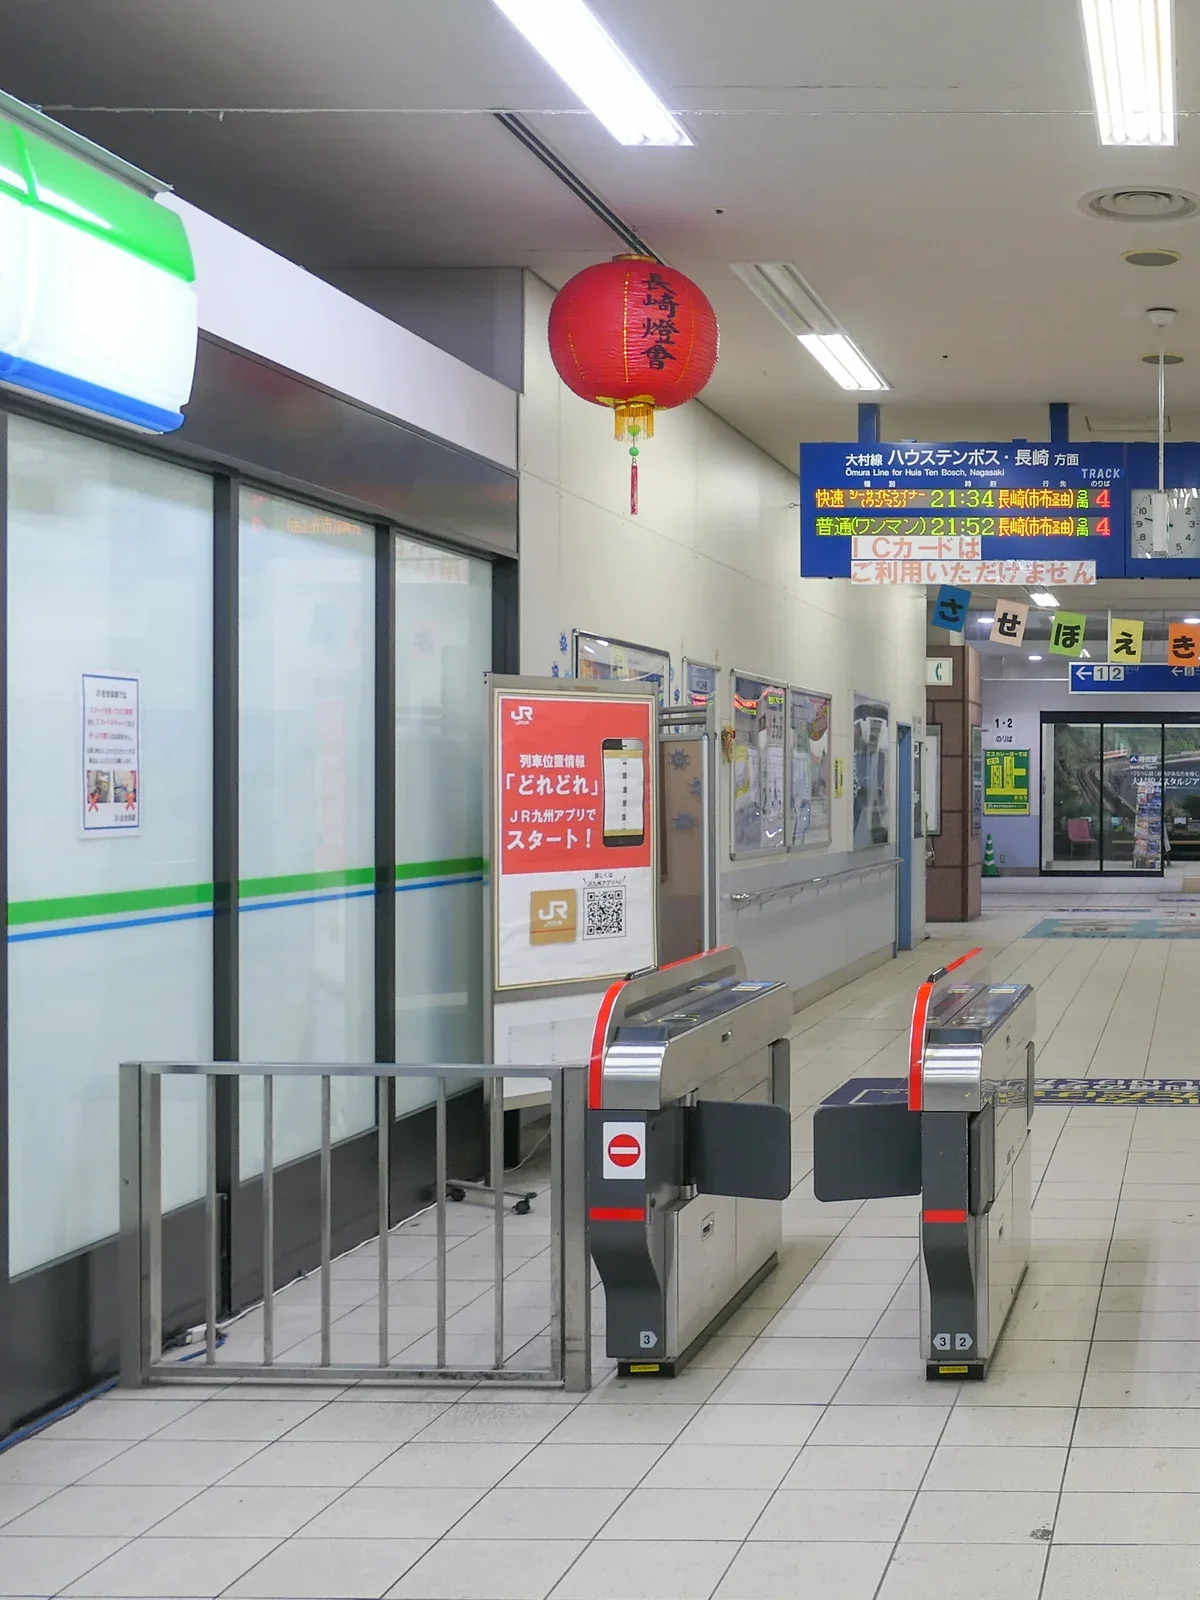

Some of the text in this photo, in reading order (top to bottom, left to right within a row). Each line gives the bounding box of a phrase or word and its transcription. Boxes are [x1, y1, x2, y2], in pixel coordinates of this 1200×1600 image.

[845, 449, 1080, 467] 大村線 ハウステンボス・長崎 方面
[941, 469, 968, 478] Bosch,
[970, 469, 1005, 478] Nagasaki
[1081, 468, 1120, 479] TRACK
[815, 489, 845, 508] 快速
[930, 489, 995, 508] 21:34
[1095, 489, 1111, 508] 4
[930, 517, 995, 536] 21:52
[1095, 517, 1111, 536] 4
[852, 561, 1095, 584] ご利用いただけません
[510, 705, 534, 722] JR
[519, 754, 585, 769] 列車位置情報
[505, 772, 599, 796] 「どれどれ」
[510, 808, 596, 824] JR九州アプリで
[538, 900, 568, 920] JR
[643, 1334, 651, 1345] 3
[939, 1336, 947, 1347] 3
[959, 1336, 967, 1347] 2
